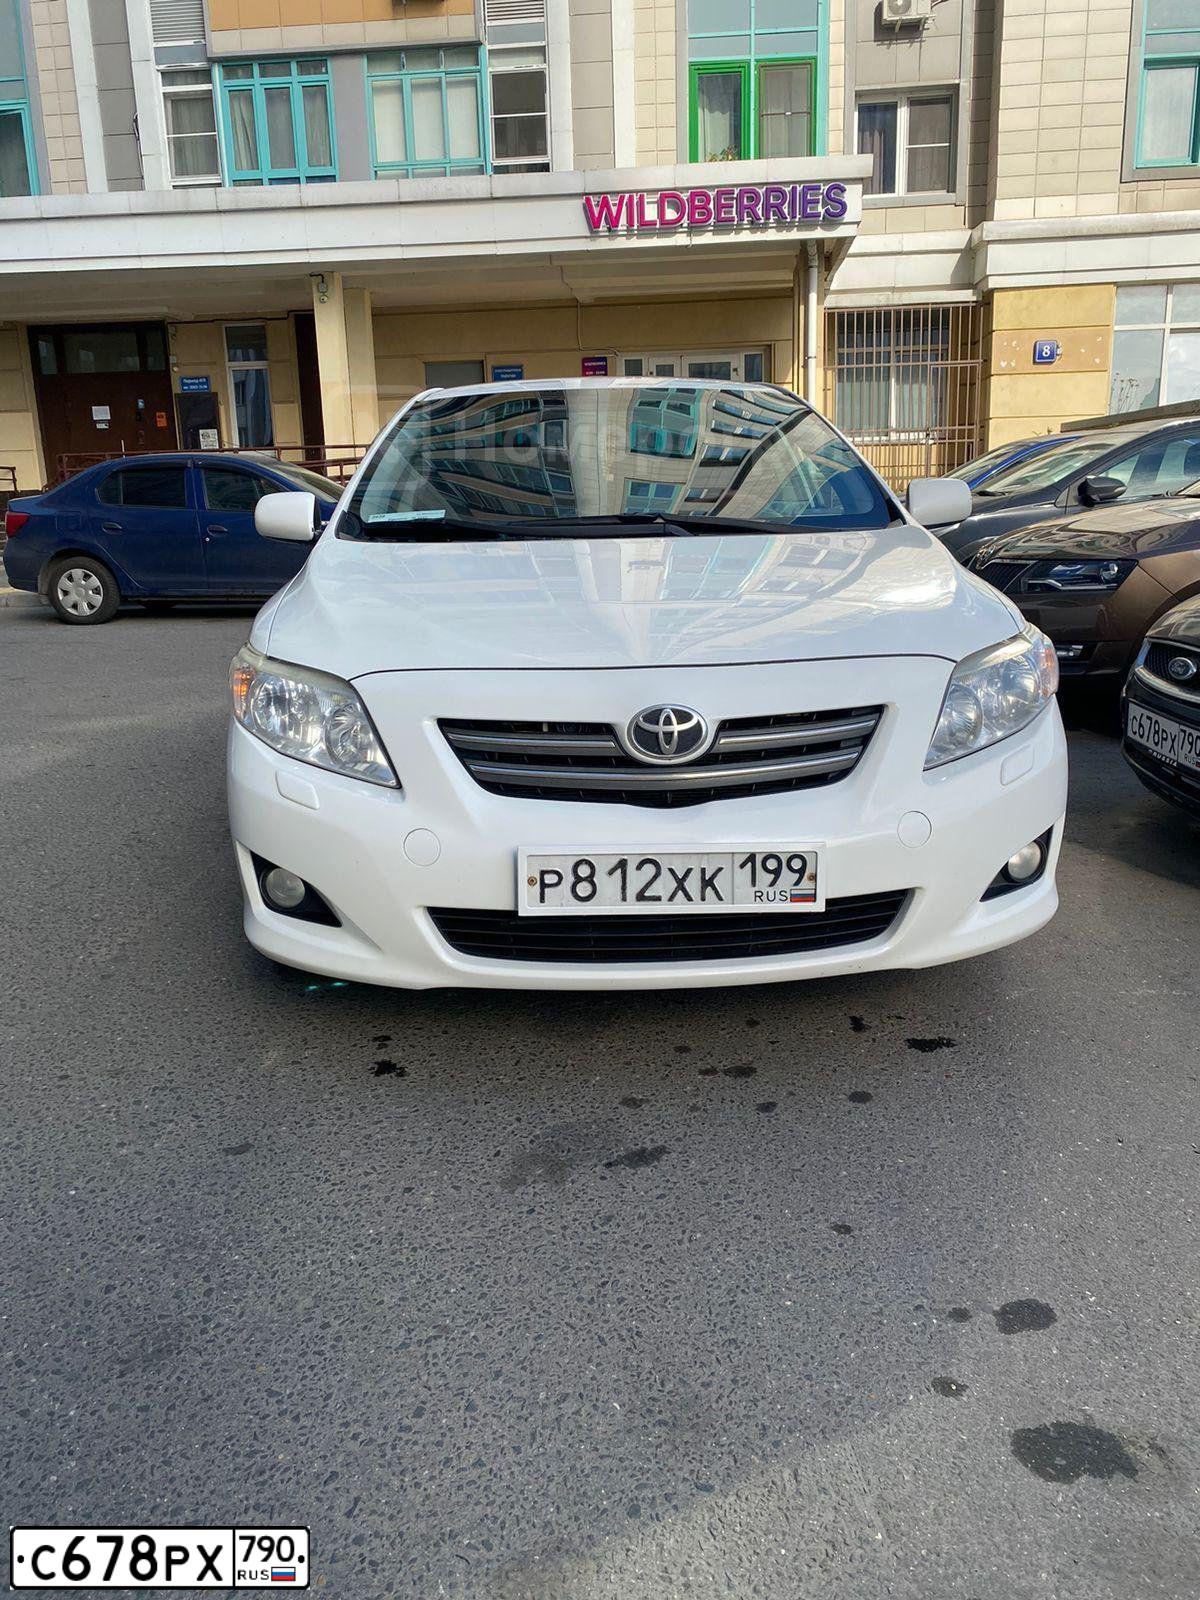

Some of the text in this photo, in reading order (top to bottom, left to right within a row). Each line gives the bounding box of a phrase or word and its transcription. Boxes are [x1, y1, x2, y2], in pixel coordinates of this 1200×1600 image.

[584, 183, 849, 231] WILDBERRIES
[1042, 345, 1051, 357] 8
[738, 853, 808, 888] 199
[754, 890, 788, 902] RUS
